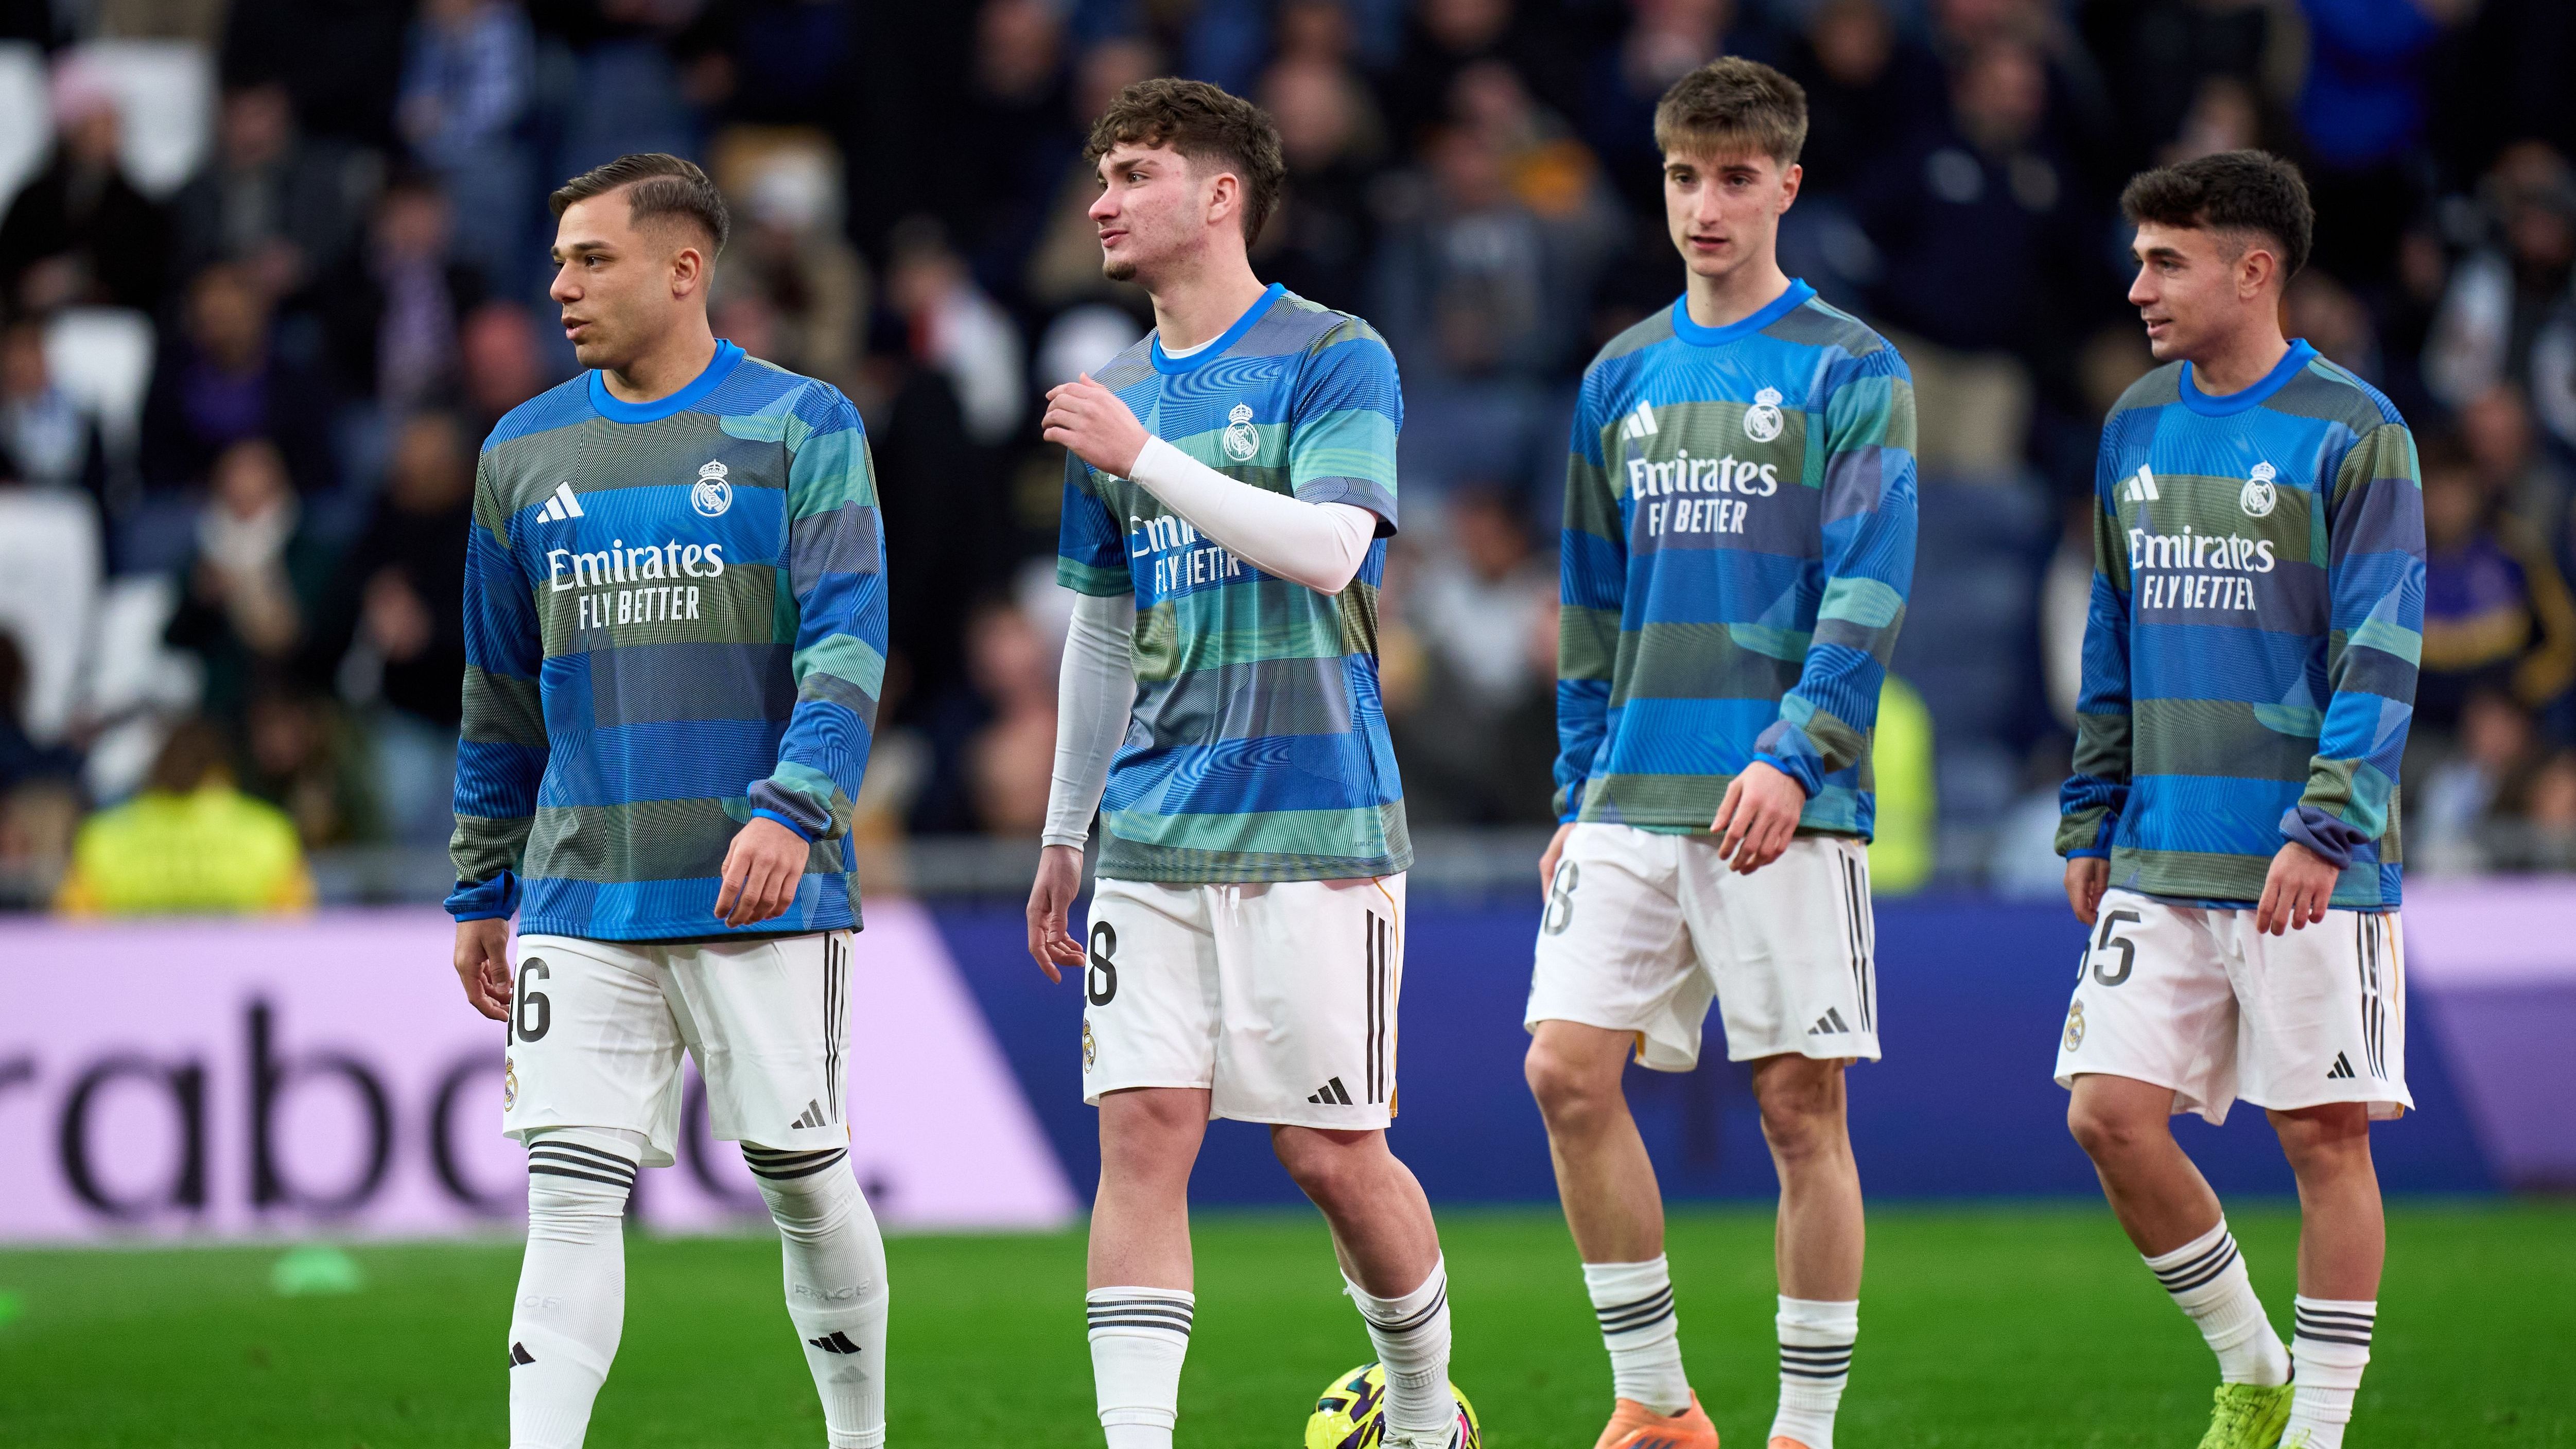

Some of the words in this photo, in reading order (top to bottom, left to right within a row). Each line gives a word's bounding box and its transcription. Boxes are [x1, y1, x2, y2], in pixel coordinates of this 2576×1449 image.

[1627, 449, 1778, 501] Emirates
[547, 537, 724, 592] Emirates
[2128, 525, 2275, 573] Emirates
[579, 592, 611, 631] FLY
[618, 586, 700, 625] BETTER
[2143, 575, 2181, 609] FLY
[2183, 575, 2256, 610] BETTER
[1084, 920, 1118, 1007] 8
[2076, 910, 2141, 987] 5
